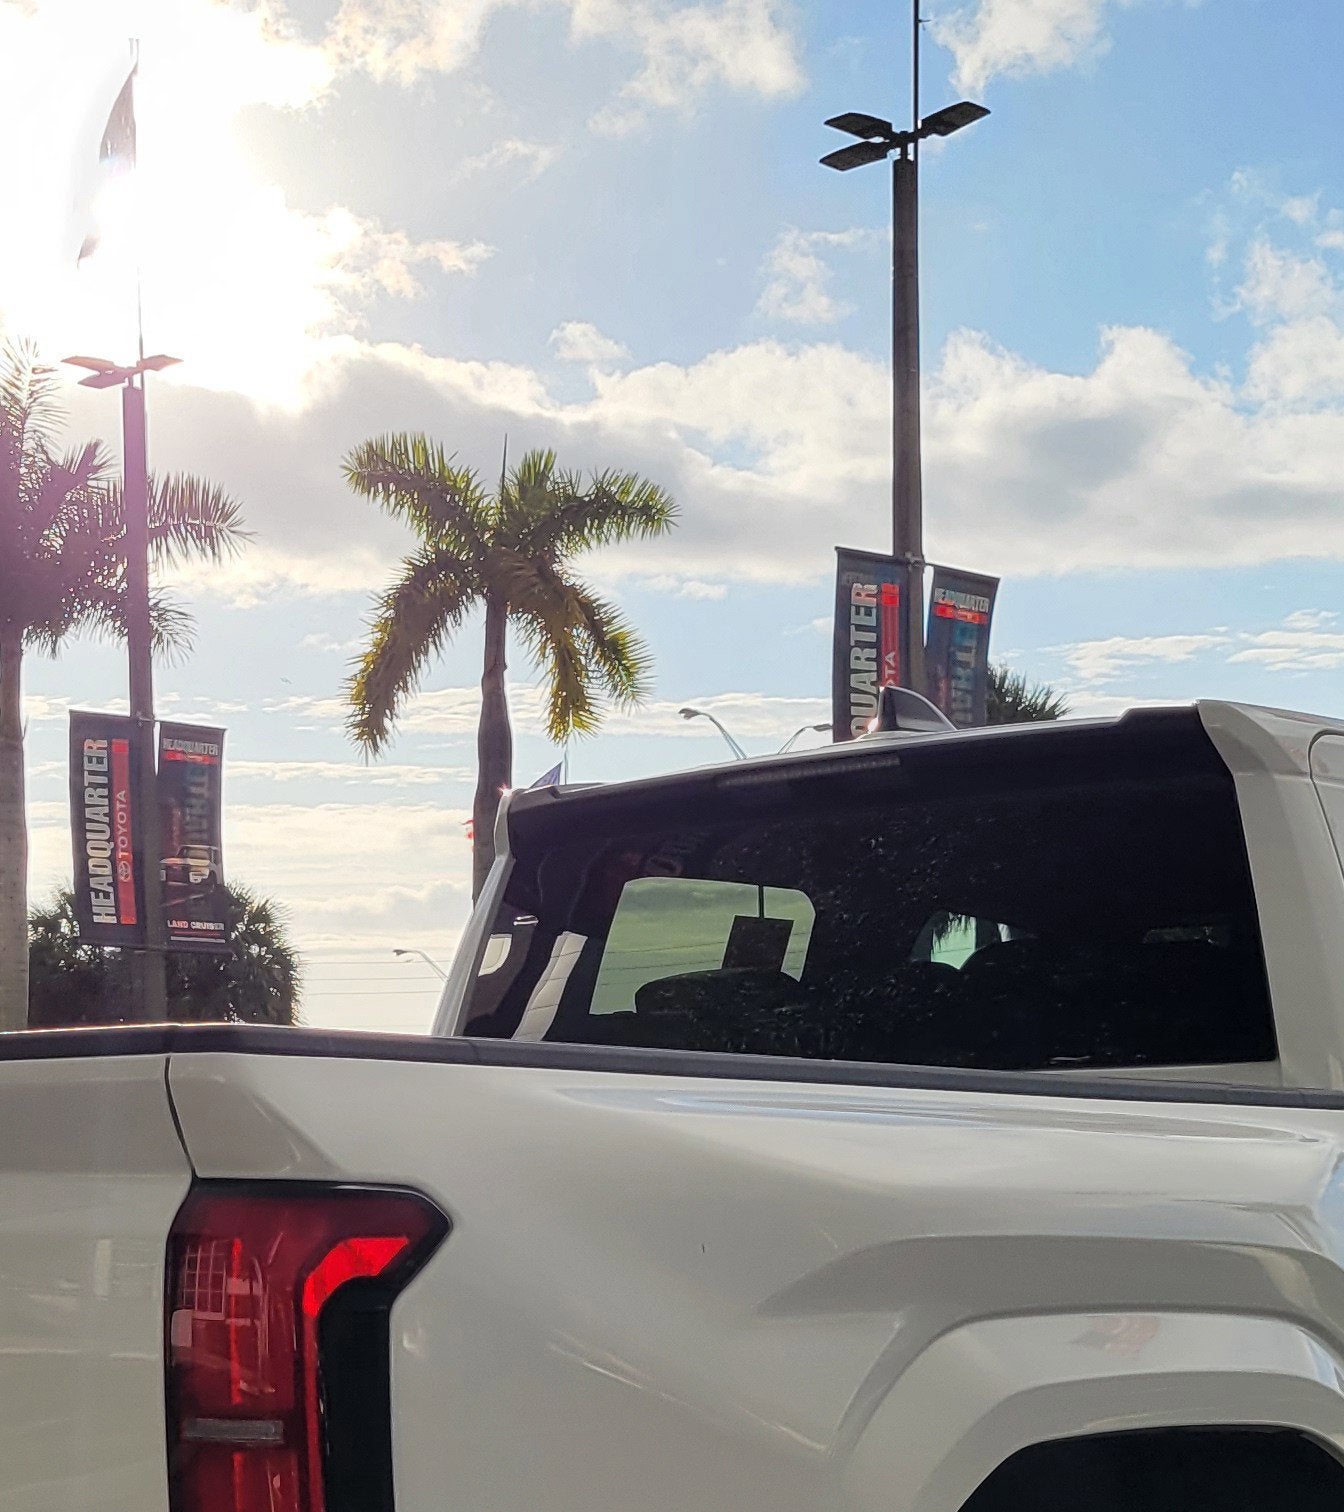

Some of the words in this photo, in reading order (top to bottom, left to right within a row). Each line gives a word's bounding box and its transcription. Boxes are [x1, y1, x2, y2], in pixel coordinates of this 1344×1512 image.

[850, 582, 879, 737] QUARTER
[83, 738, 118, 925] HEADQUARTER
[115, 789, 129, 859] TOYOTA
